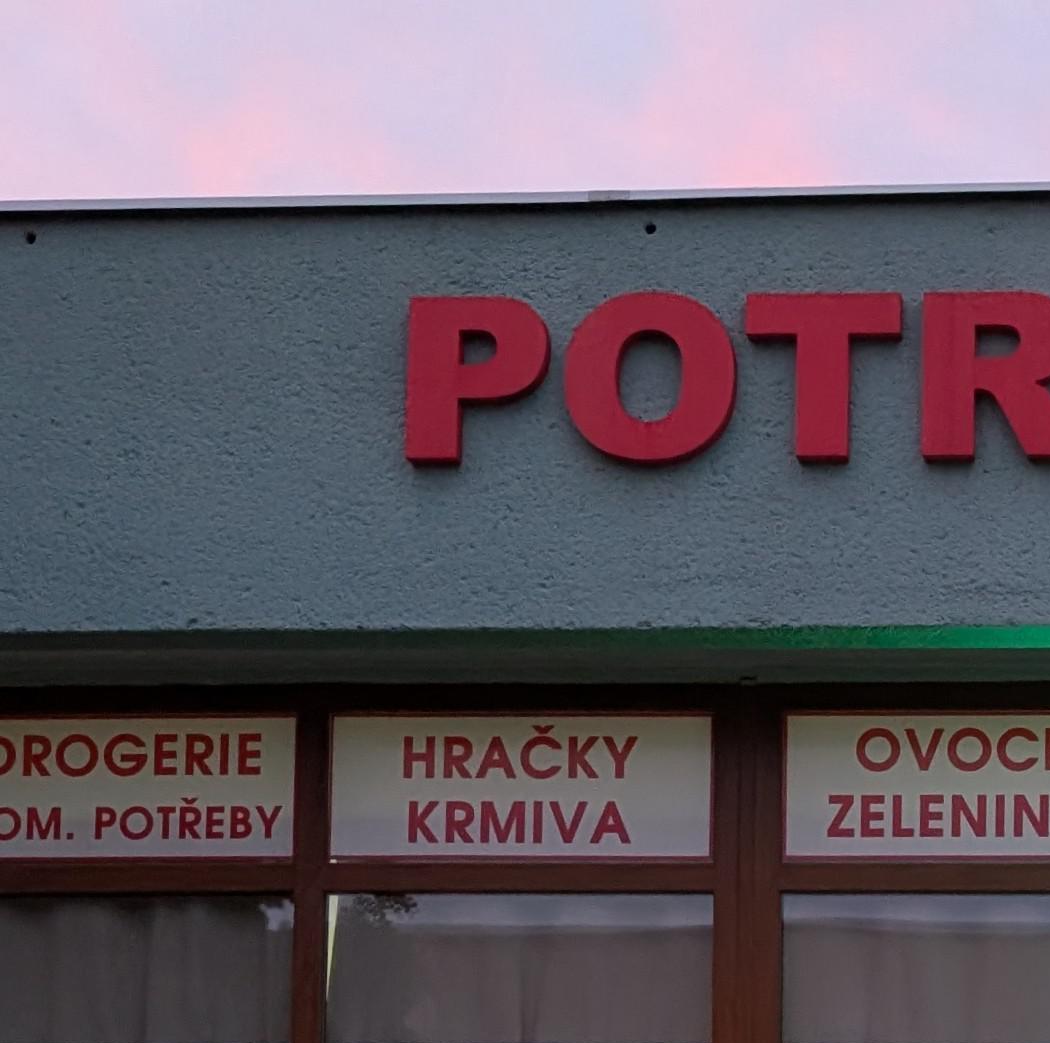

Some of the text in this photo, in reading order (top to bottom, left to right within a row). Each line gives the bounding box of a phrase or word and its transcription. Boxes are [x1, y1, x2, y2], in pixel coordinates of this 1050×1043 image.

[402, 724, 638, 779] HRAČKY
[94, 797, 283, 840] POTŘEBY
[407, 801, 632, 844] KRMIVA
